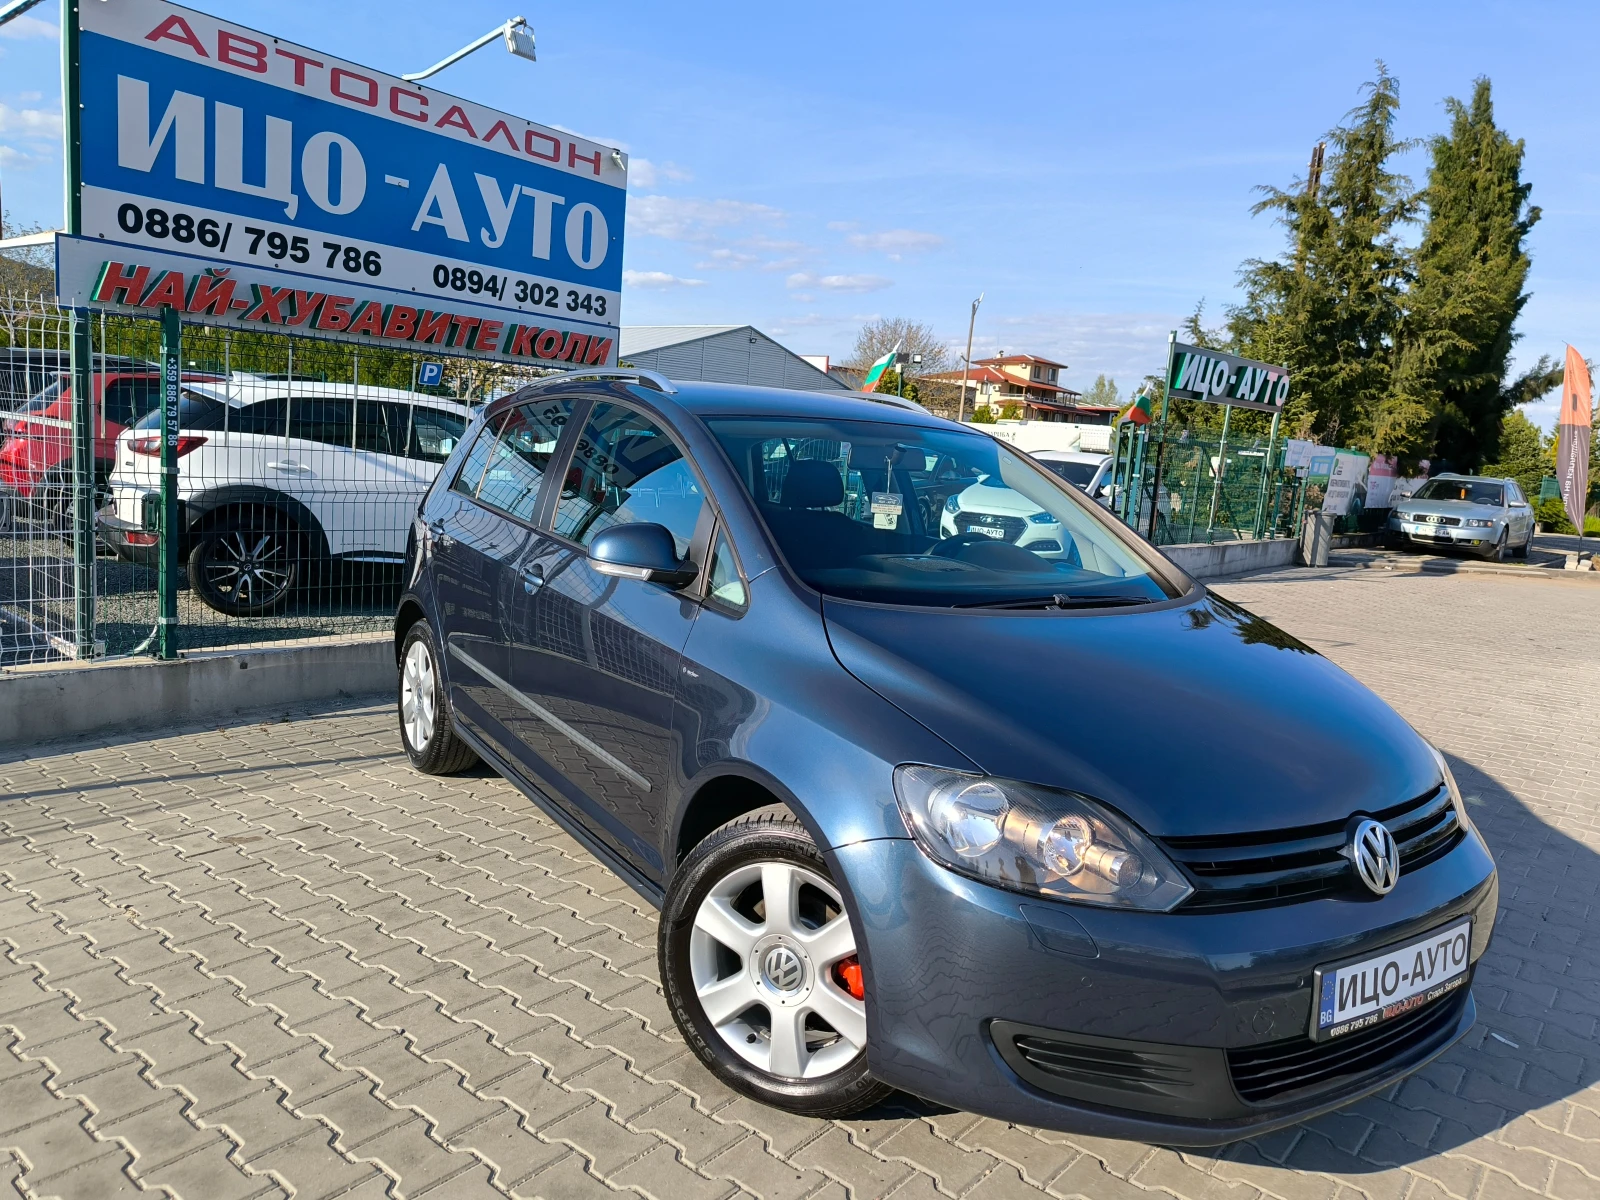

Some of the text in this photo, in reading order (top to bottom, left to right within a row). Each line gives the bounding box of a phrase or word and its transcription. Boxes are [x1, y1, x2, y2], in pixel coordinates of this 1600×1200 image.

[145, 14, 601, 176] АВТОСАЛОН
[117, 203, 382, 277] 0886/ 795 786
[95, 260, 613, 366] НАЙ-ХУБАВИТЕ КОЛИ
[432, 264, 607, 317] 0894/ 302 343
[166, 357, 178, 446] +359 886 79 57 86
[423, 364, 438, 382] P
[1338, 933, 1467, 1013] ИЦО-АУТО
[1320, 1009, 1333, 1025] BG
[1331, 1013, 1379, 1037] 0886 795 786
